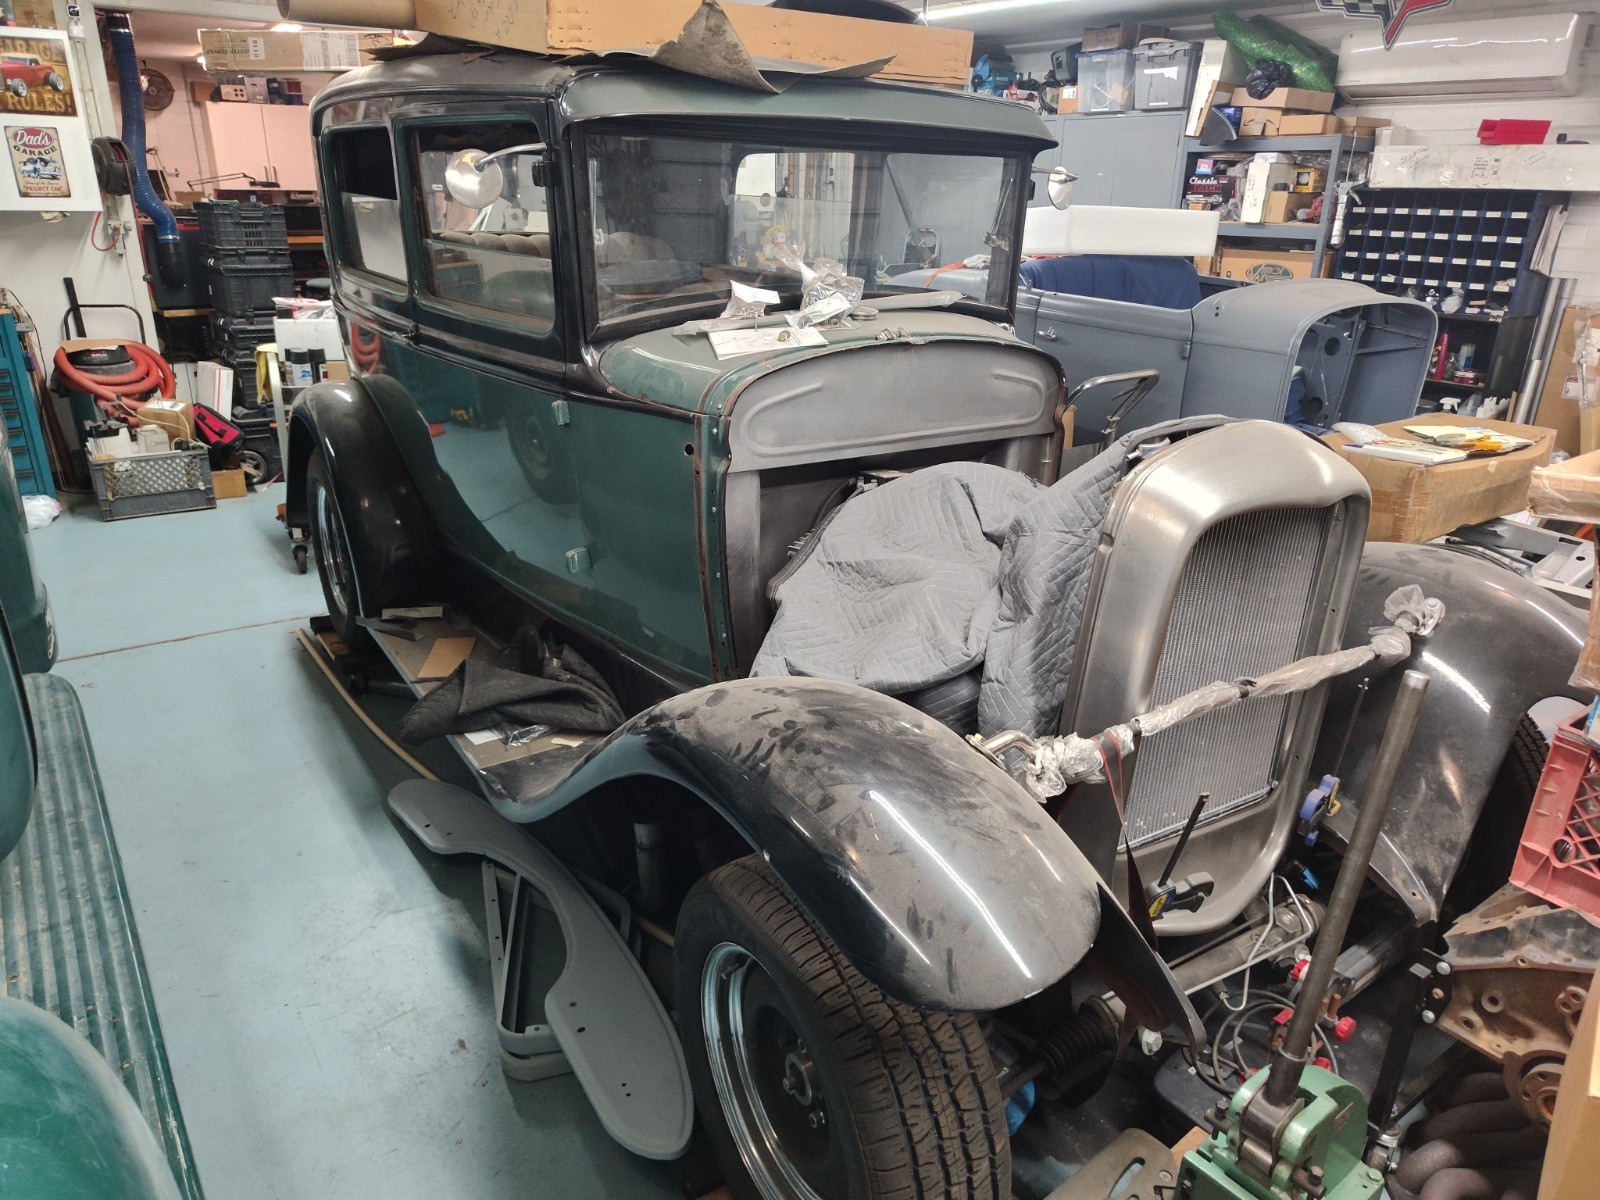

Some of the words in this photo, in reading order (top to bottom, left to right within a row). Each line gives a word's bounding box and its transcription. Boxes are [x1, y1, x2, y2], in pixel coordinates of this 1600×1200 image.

[6, 92, 72, 112] RULES!
[16, 130, 51, 145] Dad's
[13, 144, 58, 156] GARAGE
[1189, 176, 1218, 184] Classic
